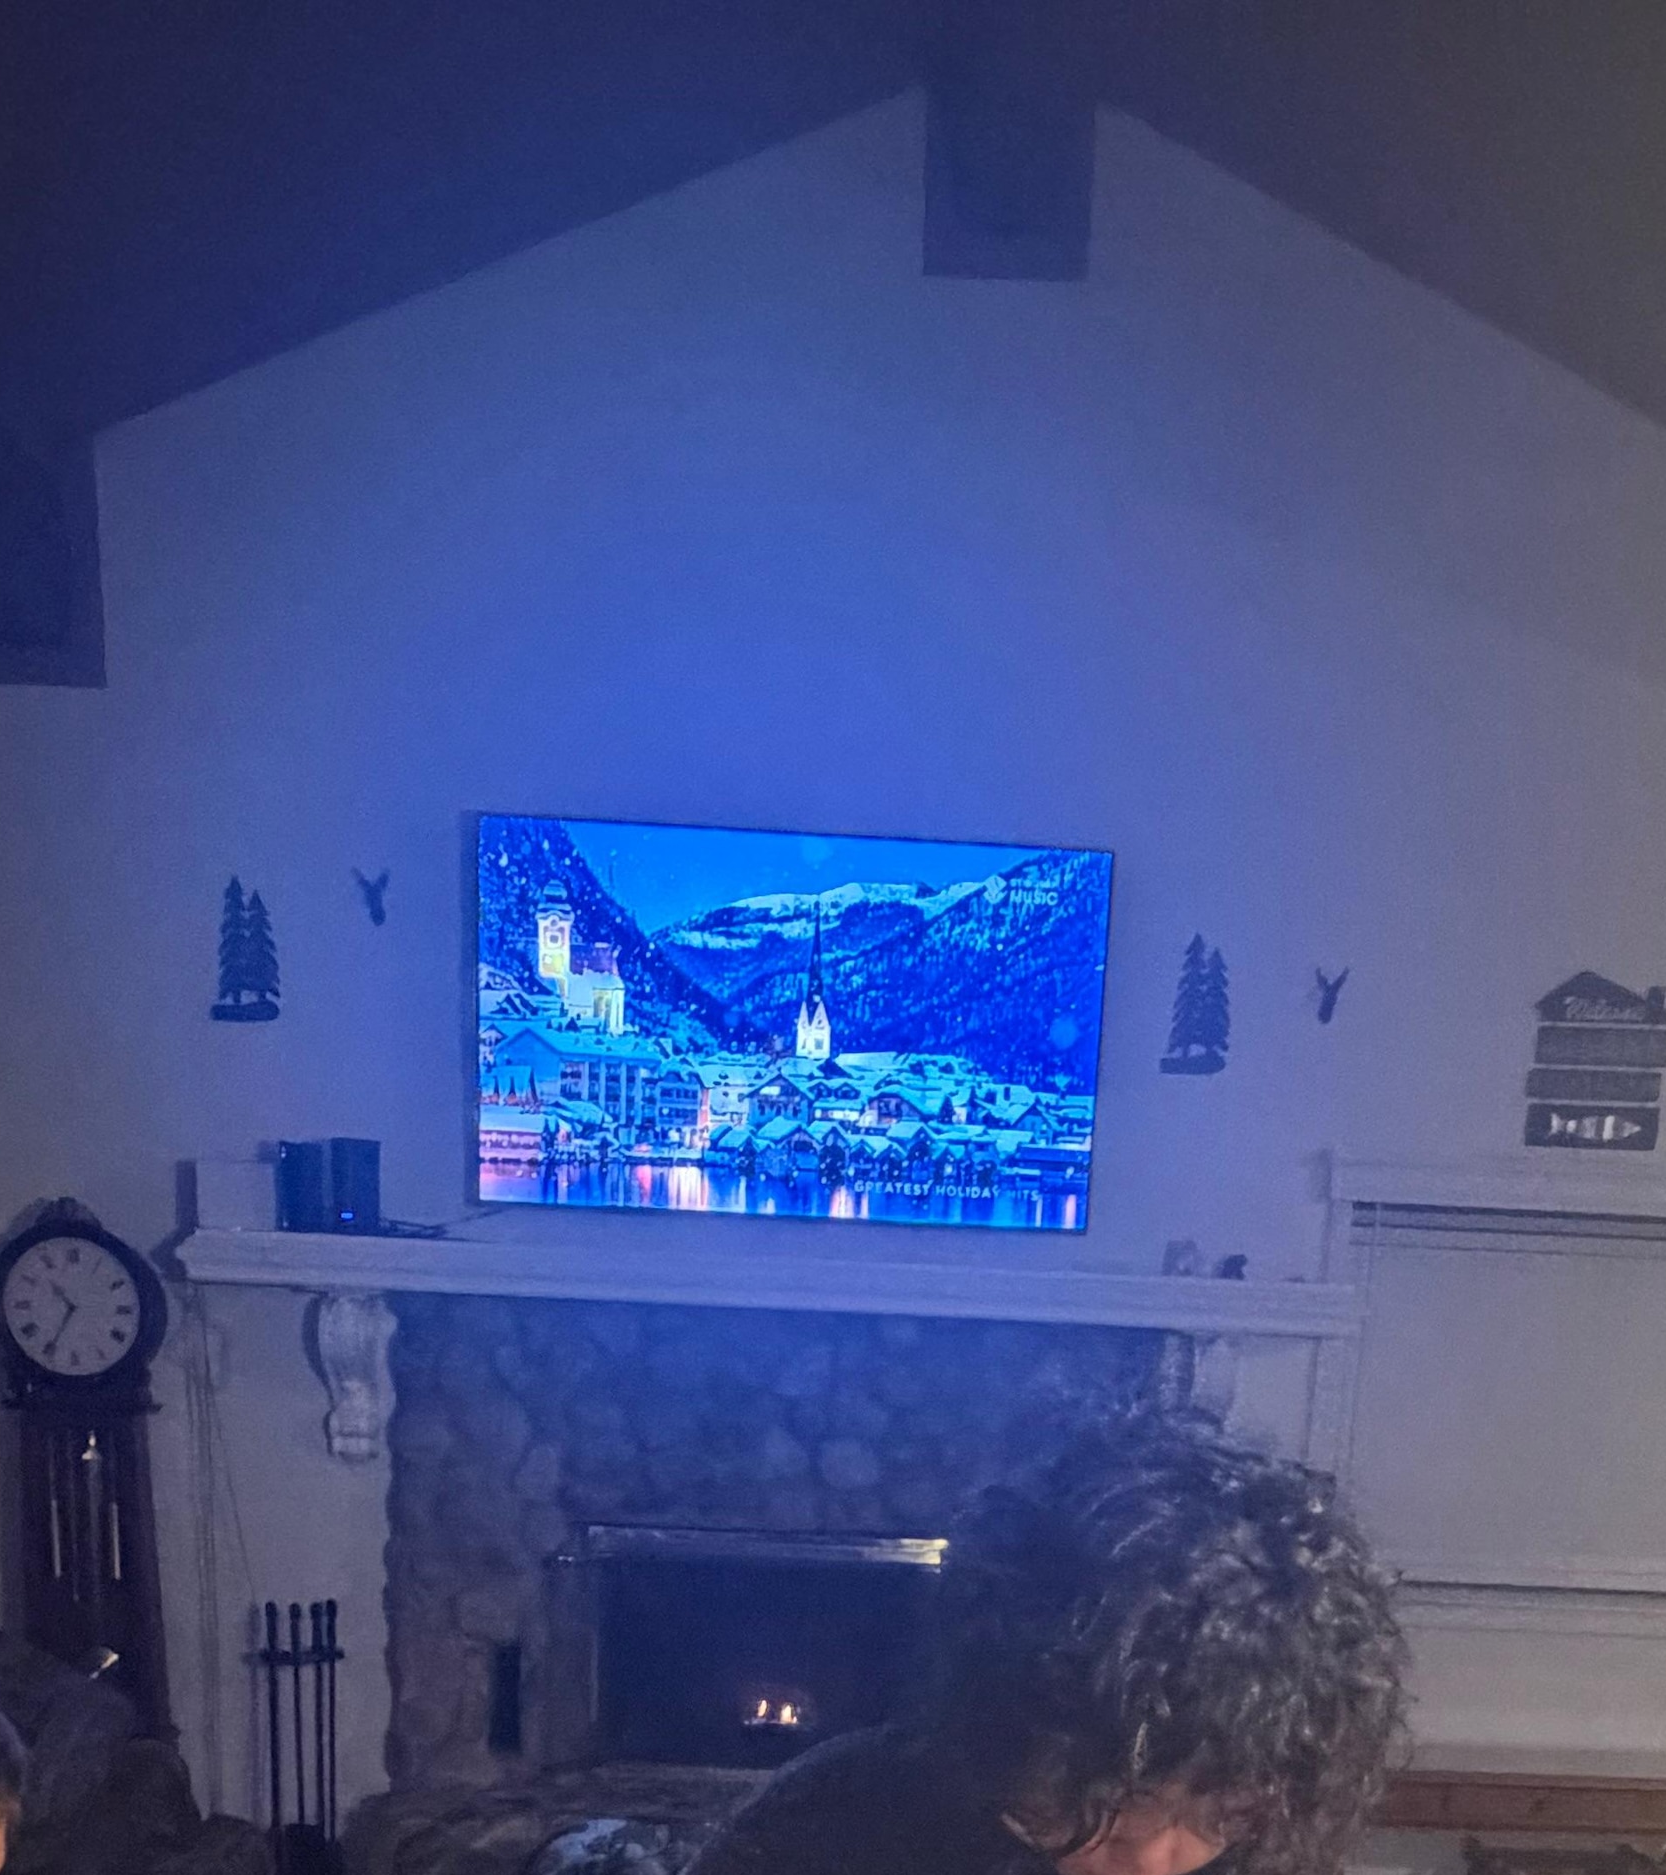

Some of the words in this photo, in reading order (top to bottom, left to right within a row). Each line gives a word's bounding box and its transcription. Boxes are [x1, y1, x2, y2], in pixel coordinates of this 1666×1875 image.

[1010, 888, 1059, 906] MUSIC
[854, 1179, 931, 1196] GREATEST
[935, 1184, 1001, 1199] HOLIDAY
[1008, 1189, 1040, 1202] HITS
